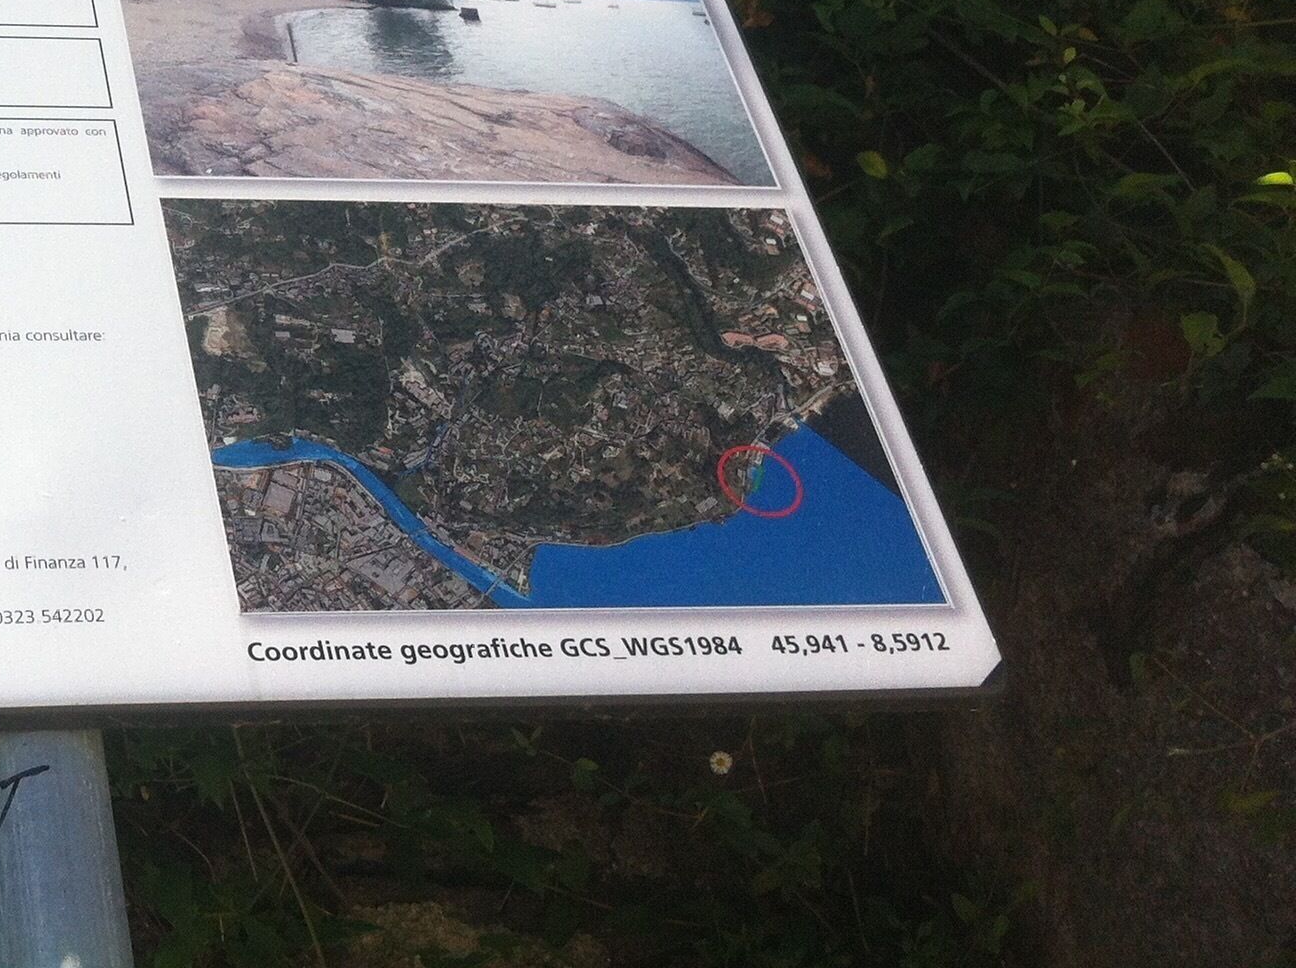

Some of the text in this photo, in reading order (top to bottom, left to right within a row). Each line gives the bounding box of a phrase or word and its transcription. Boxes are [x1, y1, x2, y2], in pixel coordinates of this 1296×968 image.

[4, 557, 19, 570] di
[24, 556, 86, 570] Finanza
[92, 555, 128, 571] 117,
[247, 640, 392, 662] Coordinate
[400, 637, 553, 665] geografiche
[560, 636, 743, 660] GCS_WGS1984
[771, 634, 849, 657] 45,941
[870, 632, 950, 655] 8,5912
